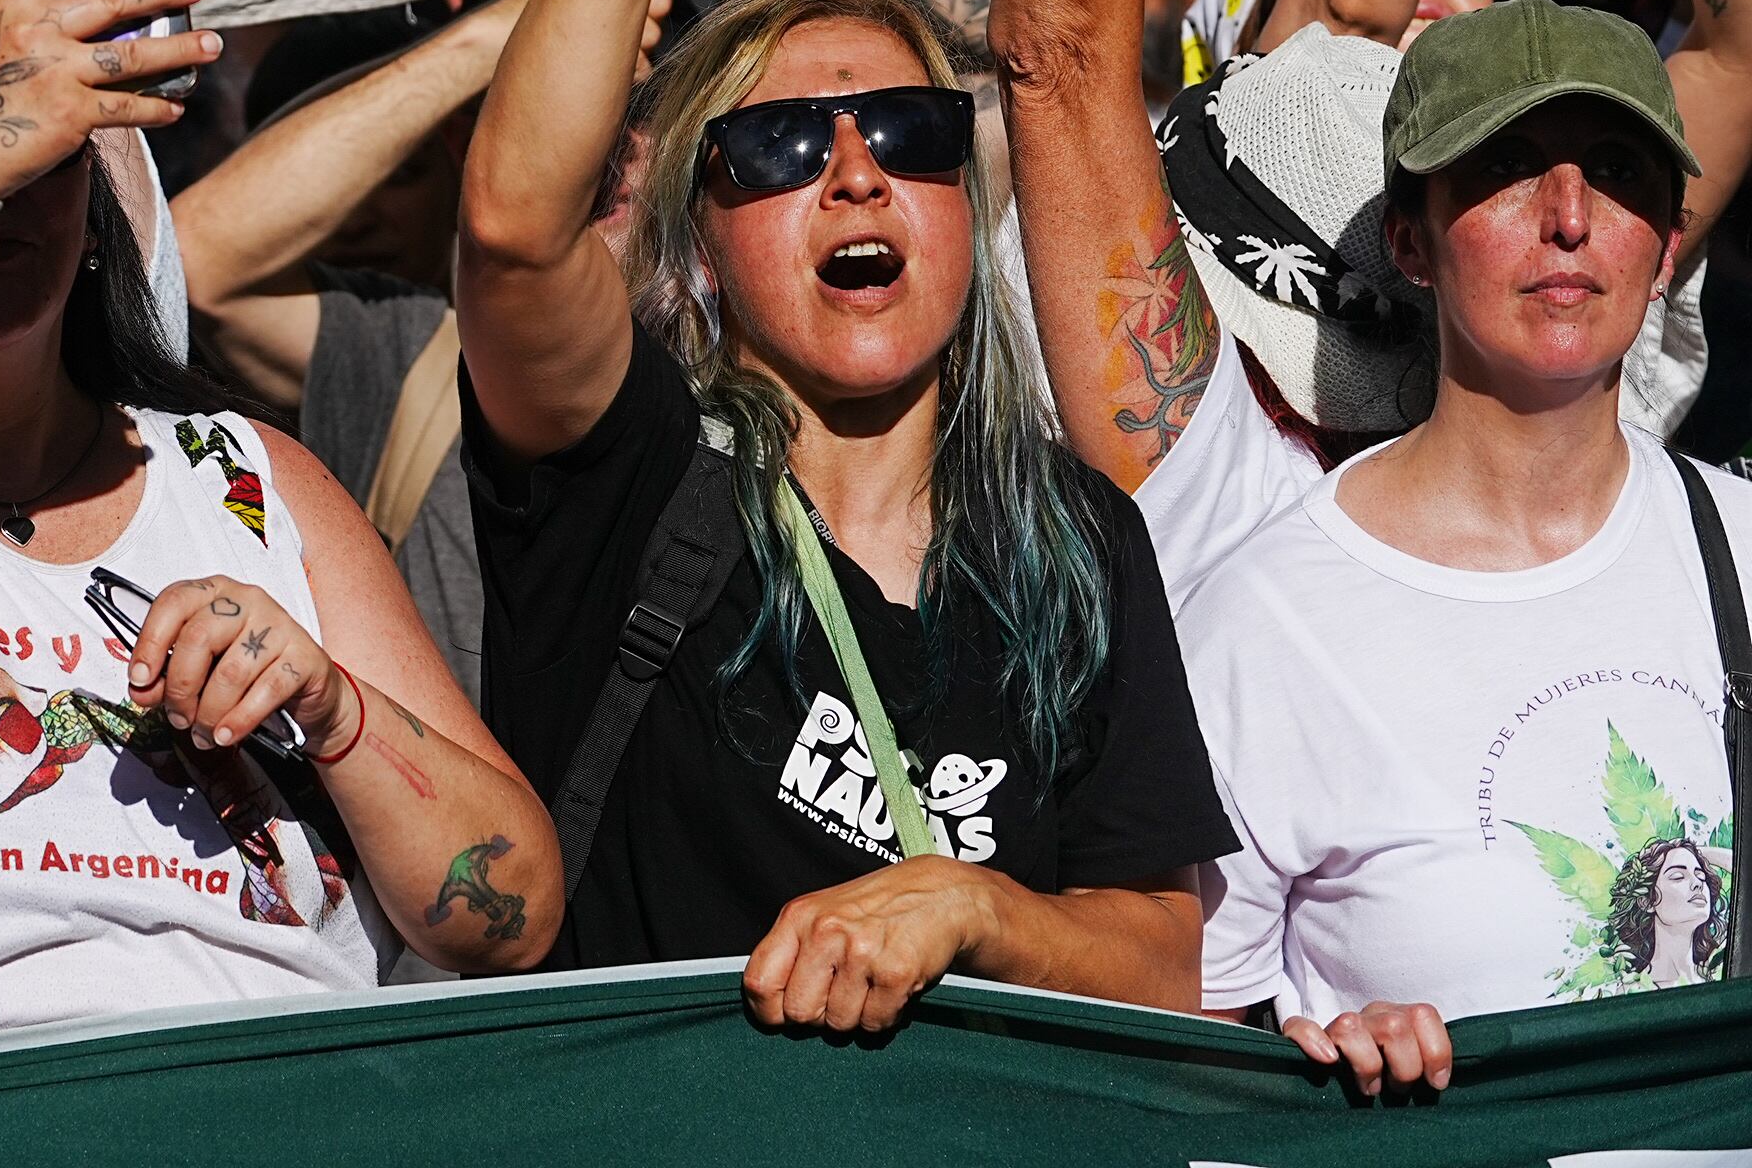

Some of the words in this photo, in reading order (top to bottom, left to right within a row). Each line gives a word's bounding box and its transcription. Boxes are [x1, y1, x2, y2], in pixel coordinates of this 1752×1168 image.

[50, 633, 84, 674] y
[1477, 766, 1497, 851] TRIBU
[1488, 725, 1515, 760] DE
[1514, 668, 1623, 725] MUJERES
[40, 840, 230, 896] Argenina
